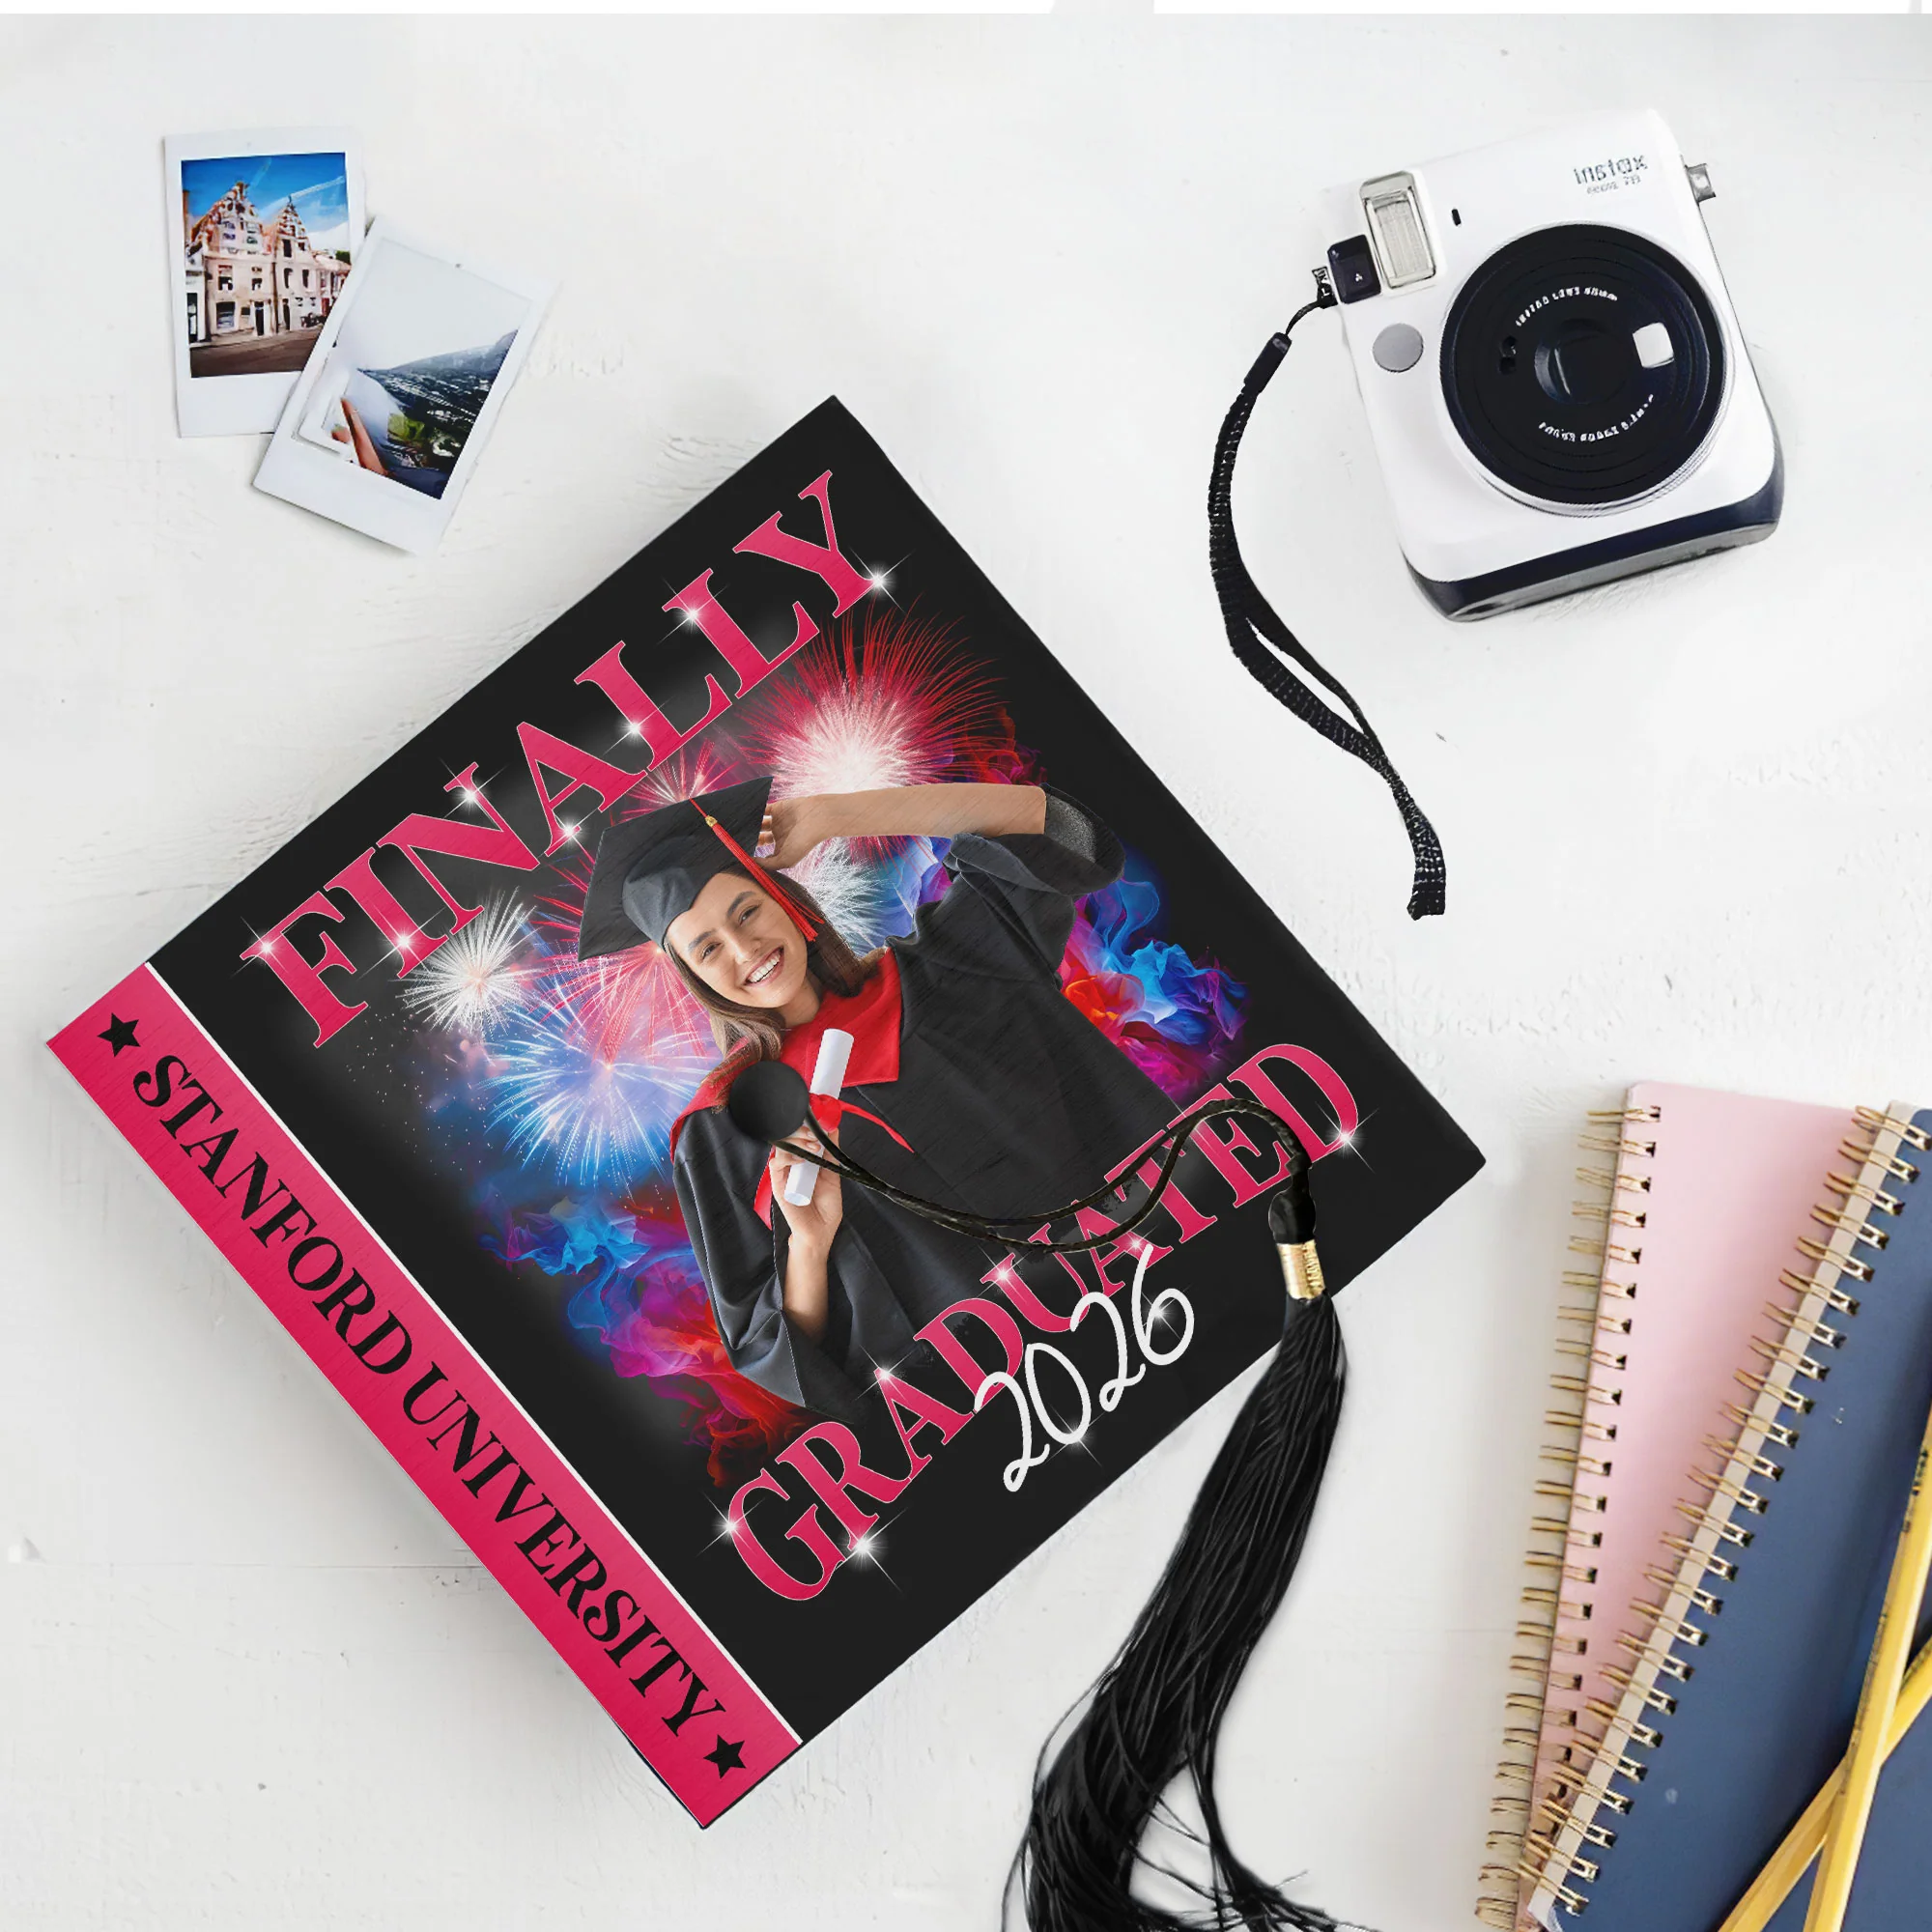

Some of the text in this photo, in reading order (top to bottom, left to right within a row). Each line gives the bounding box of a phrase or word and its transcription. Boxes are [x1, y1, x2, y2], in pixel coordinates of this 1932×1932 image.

[240, 470, 876, 1047] FINALLY
[132, 1054, 726, 1737] STANFORD UNIVERSITY
[728, 1043, 1358, 1601] GRADUATED
[974, 1244, 1196, 1492] 2026
